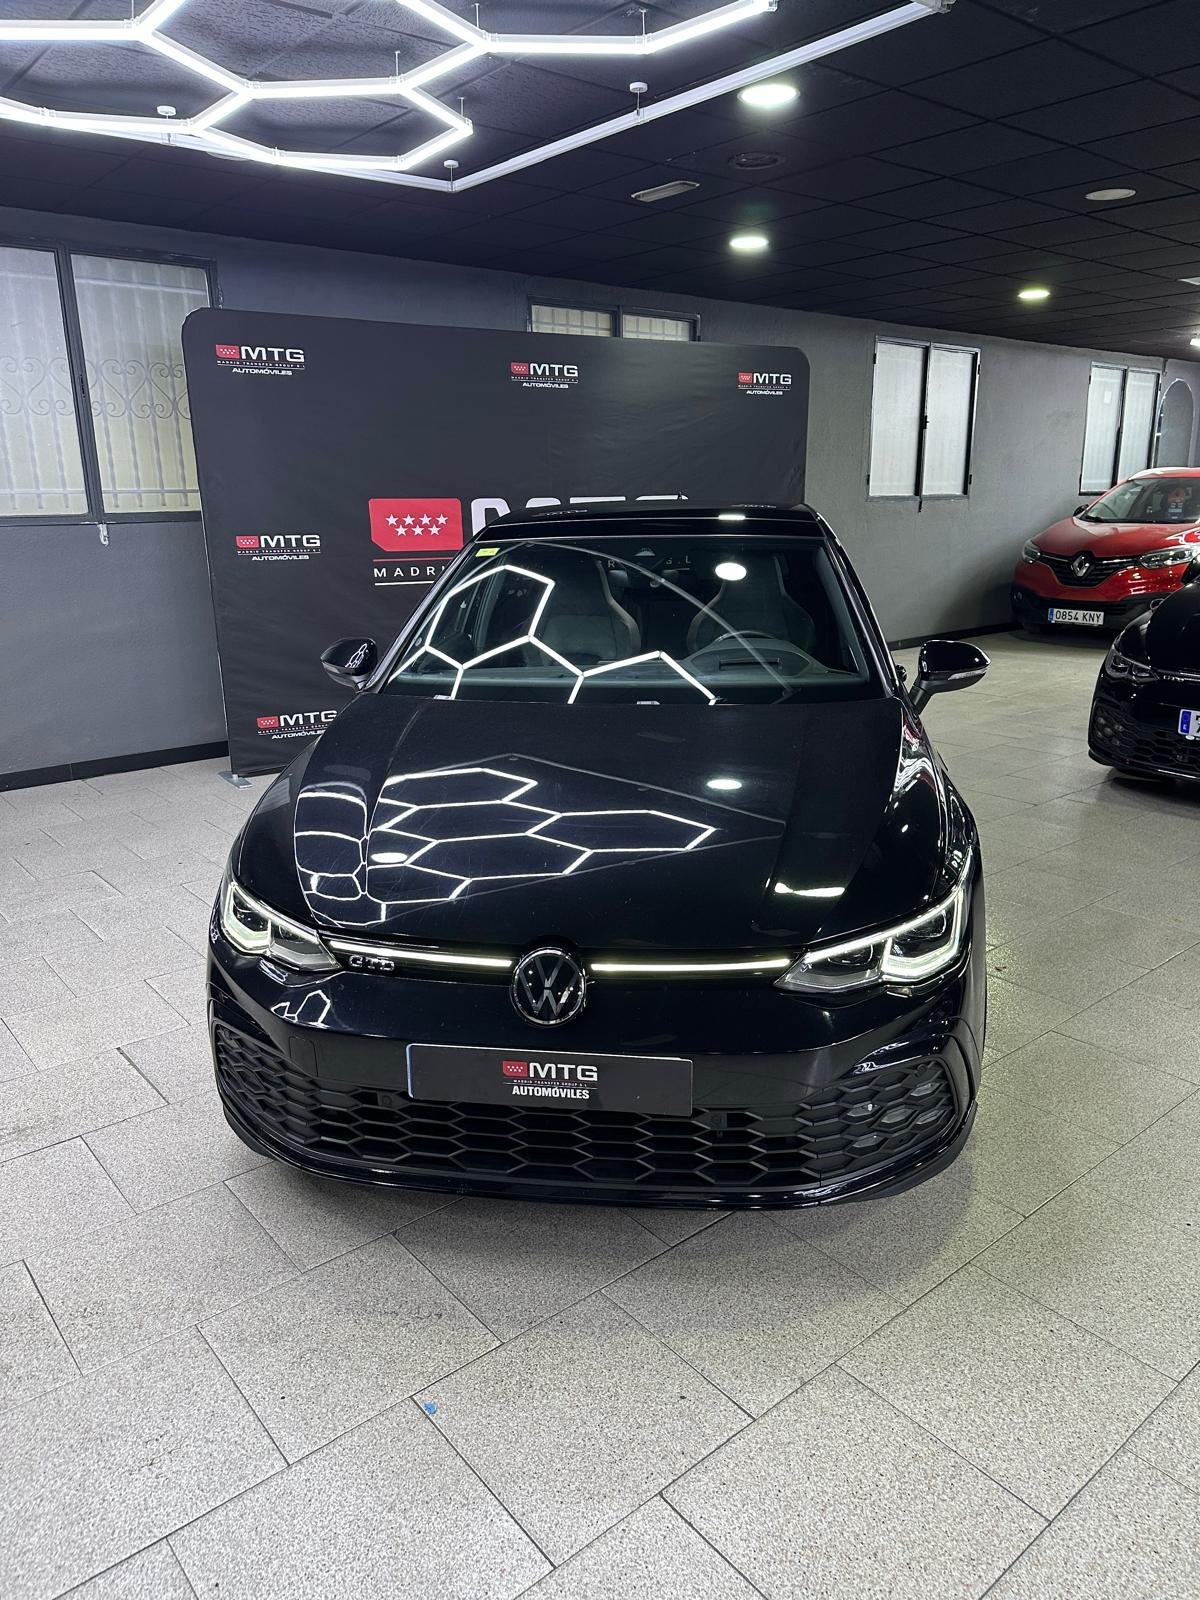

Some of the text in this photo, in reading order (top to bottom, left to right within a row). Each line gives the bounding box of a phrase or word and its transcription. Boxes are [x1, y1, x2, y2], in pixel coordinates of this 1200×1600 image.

[240, 345, 305, 363] MTG
[231, 367, 293, 376] AUTOMÓVILES
[529, 362, 579, 378] MTG
[522, 381, 569, 389] AUTOMÓVILES
[753, 372, 792, 385] MTG
[260, 534, 321, 548] MTG
[1055, 610, 1102, 623] 0854 KNY
[279, 710, 338, 727] MTG
[349, 954, 395, 971] GTD
[529, 1062, 598, 1081] MTG
[512, 1085, 590, 1099] AUTOMÓVILES
